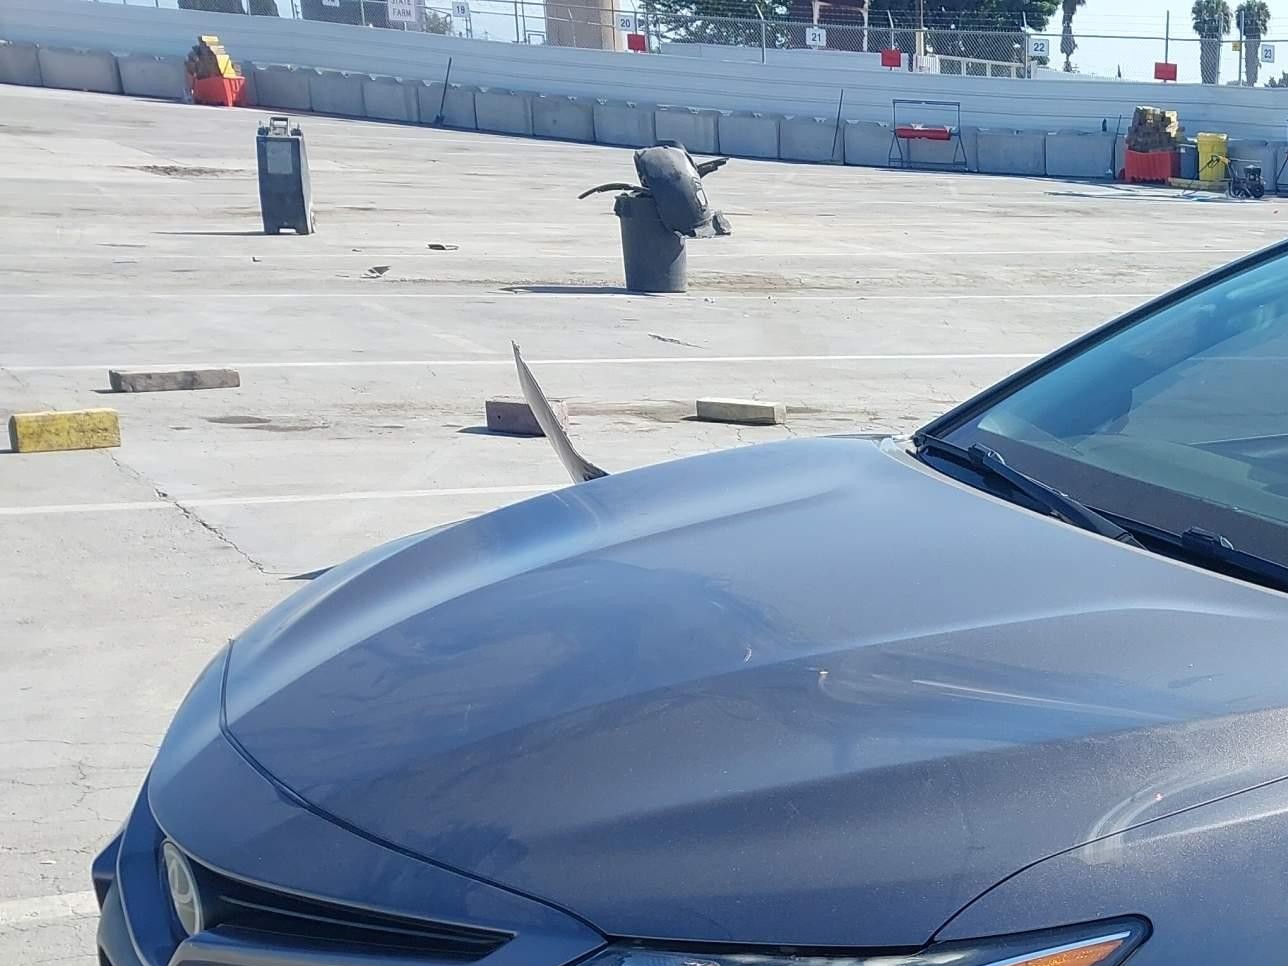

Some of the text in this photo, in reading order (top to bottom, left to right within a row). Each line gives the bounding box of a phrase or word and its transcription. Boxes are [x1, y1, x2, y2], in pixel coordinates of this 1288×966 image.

[392, 8, 412, 17] FARM
[620, 18, 631, 28] 20
[811, 33, 821, 42] 21
[1033, 42, 1045, 52] 22
[1263, 49, 1272, 59] 23
